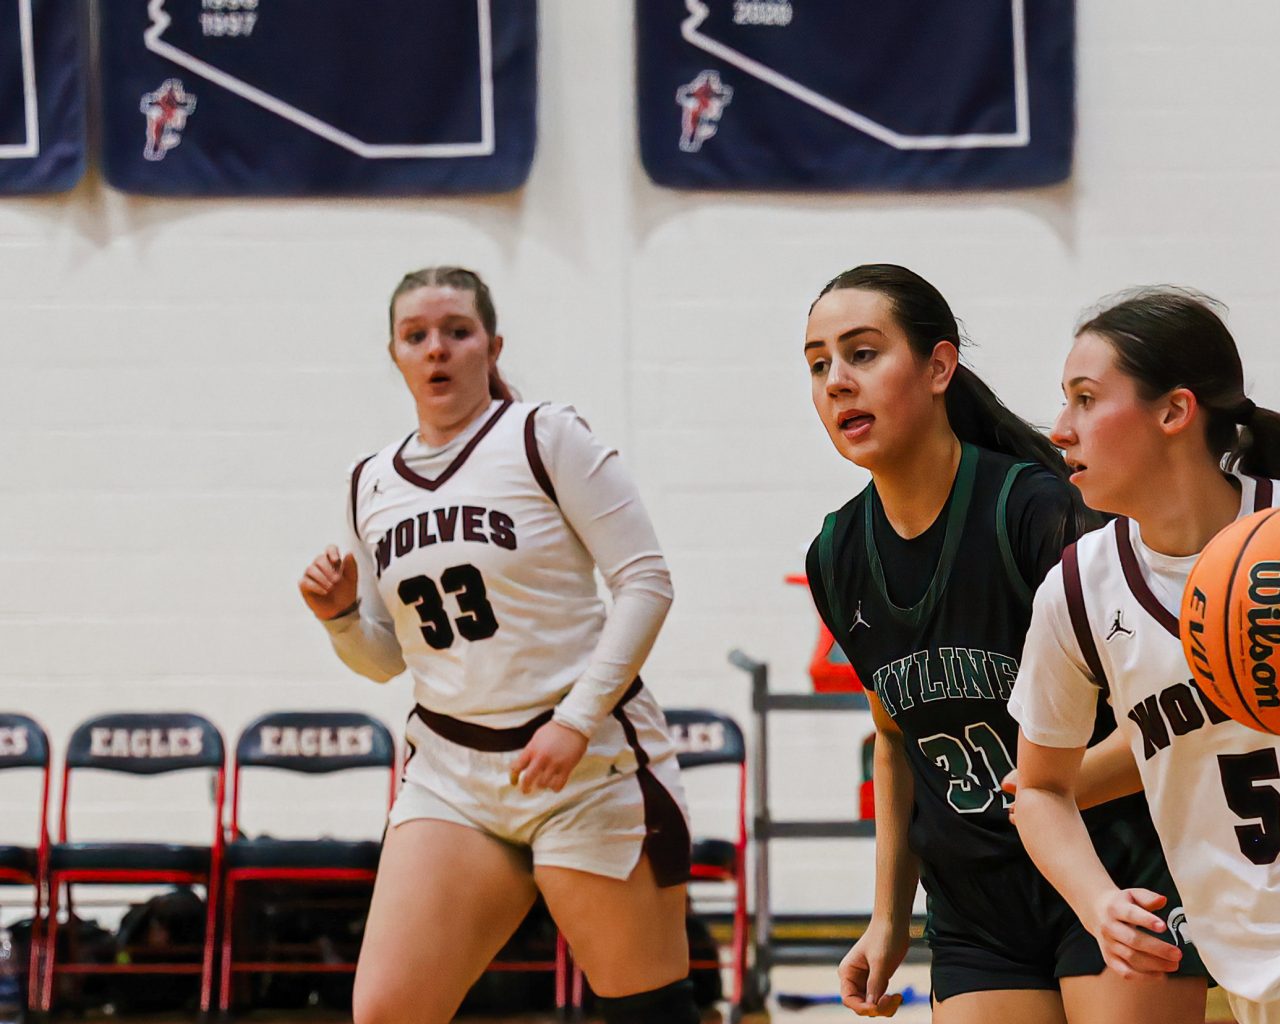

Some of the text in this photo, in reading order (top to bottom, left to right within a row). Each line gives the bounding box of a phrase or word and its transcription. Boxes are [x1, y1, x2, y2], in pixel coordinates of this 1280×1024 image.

[375, 505, 518, 580] WOLVES
[397, 563, 500, 650] 33
[872, 647, 1021, 717] KYLINE
[91, 726, 203, 757] EAGLES
[261, 725, 373, 757] EAGLES
[918, 721, 1017, 814] 31
